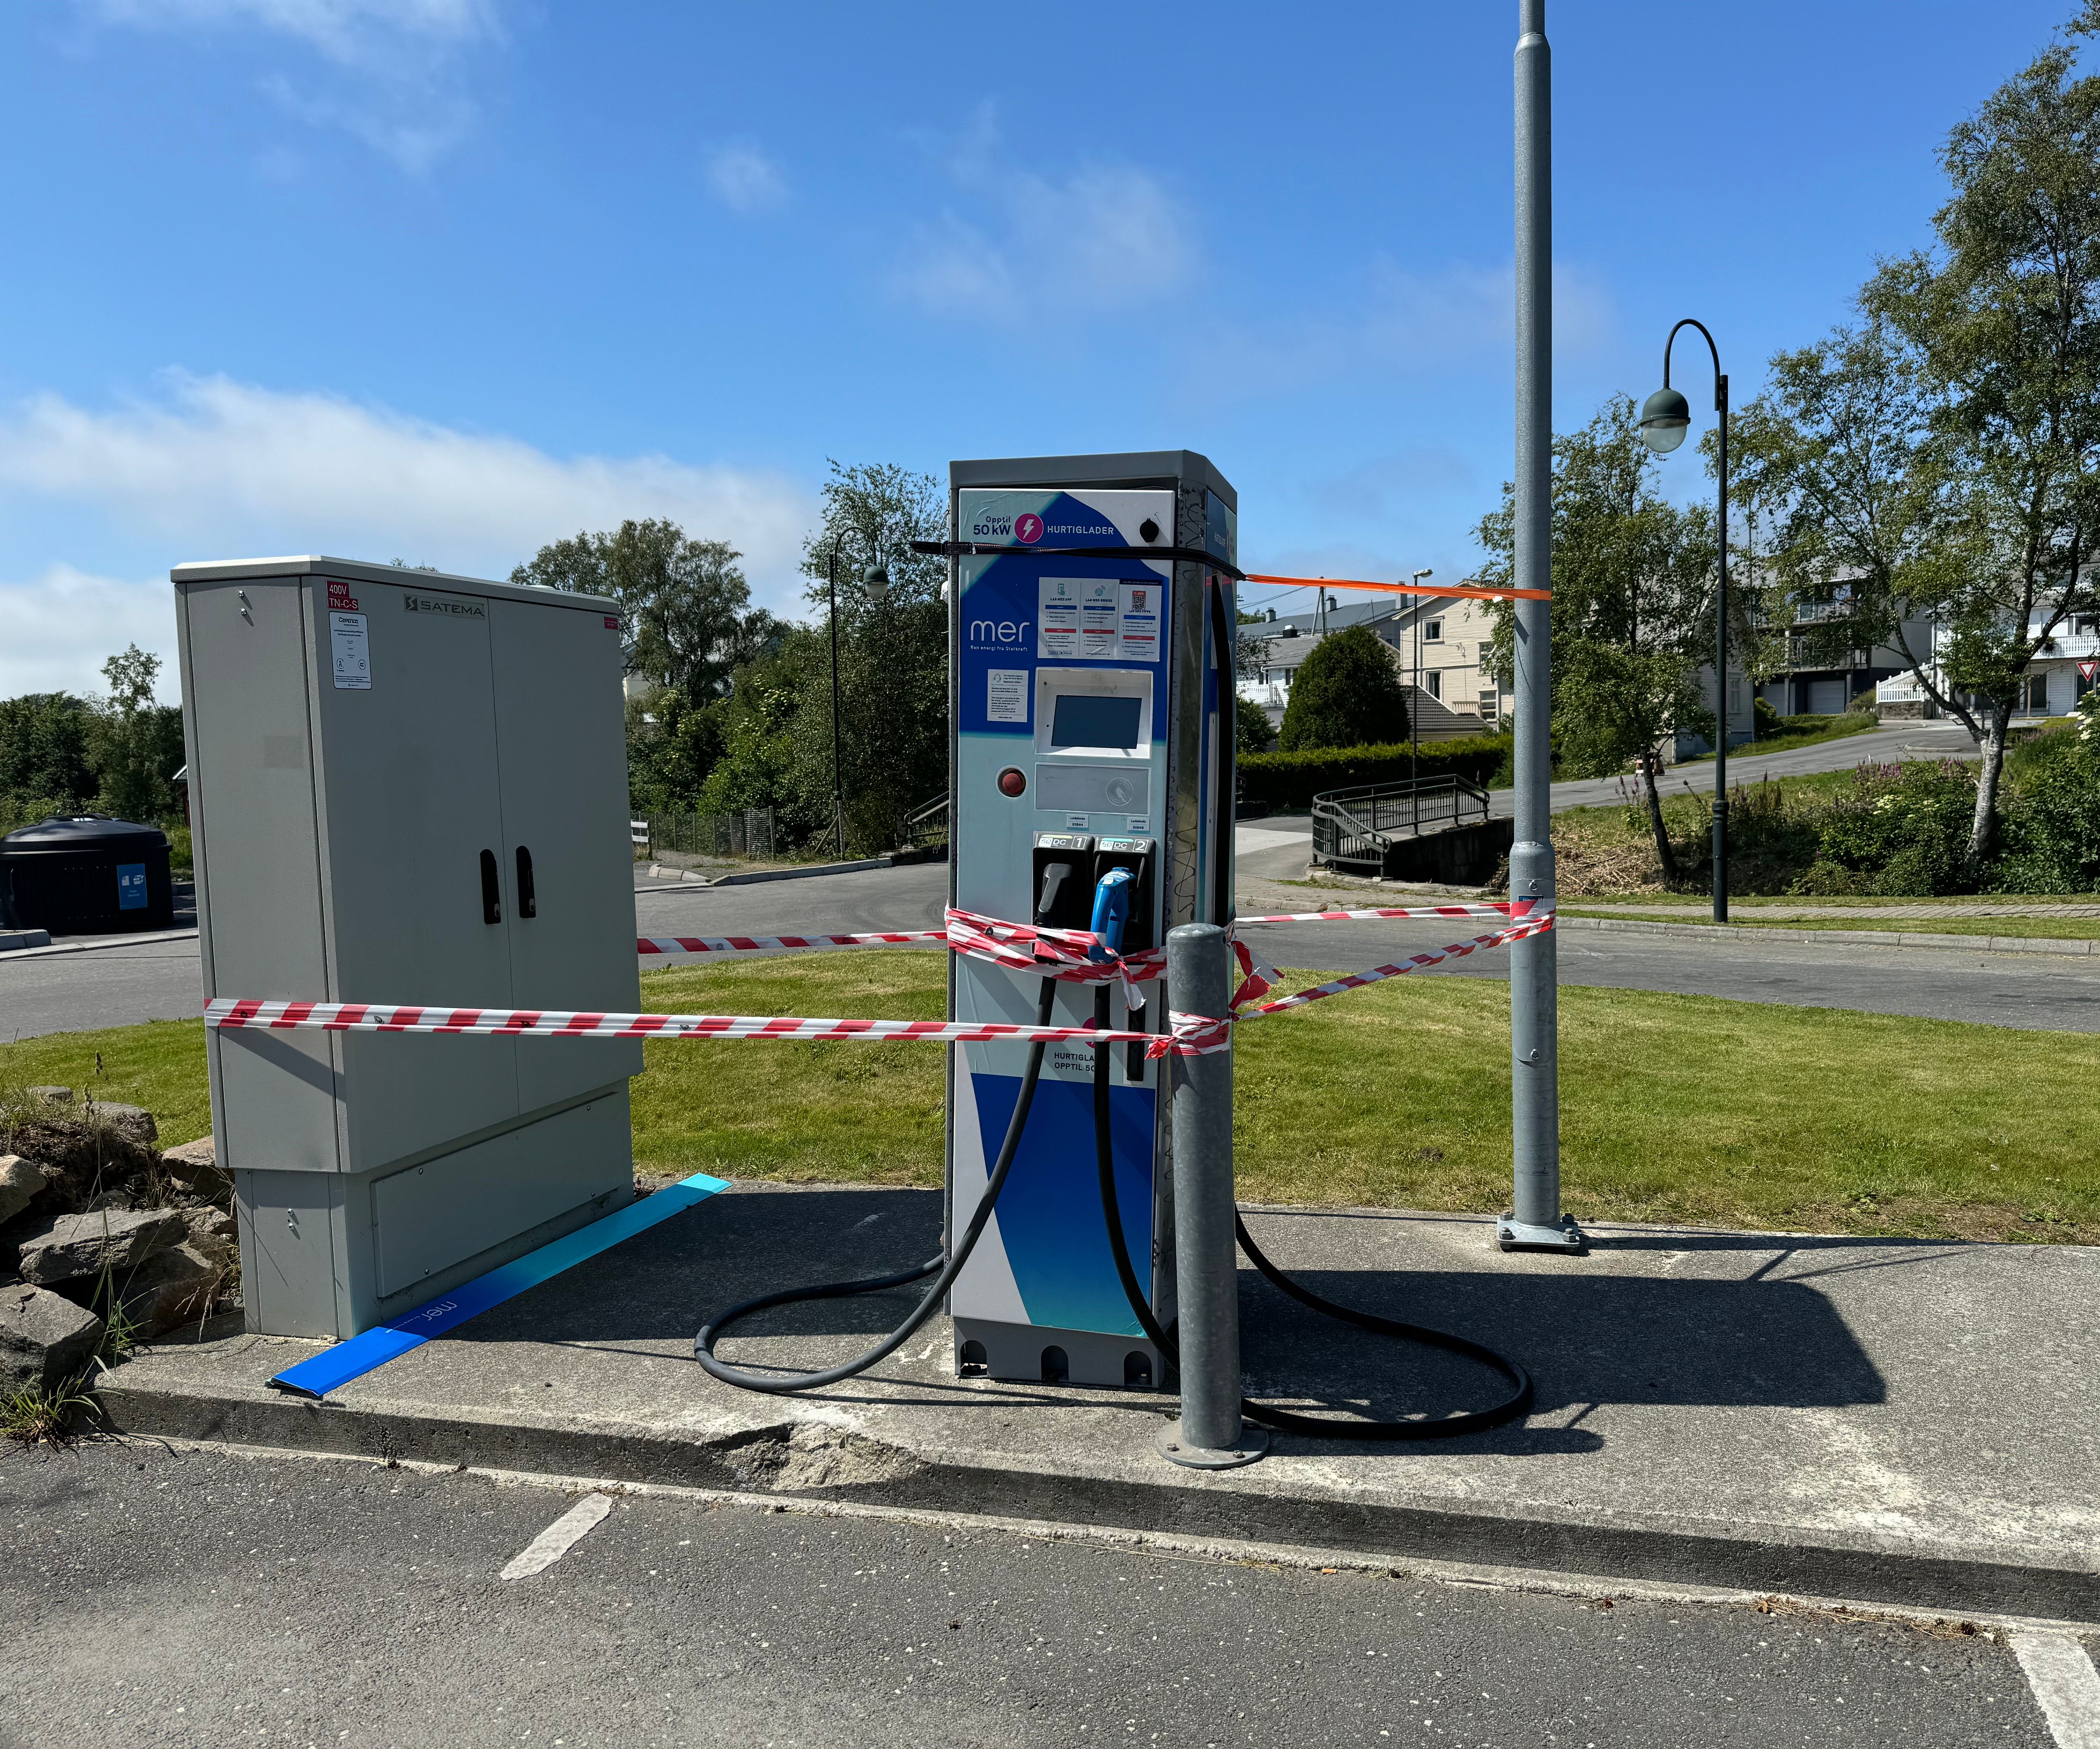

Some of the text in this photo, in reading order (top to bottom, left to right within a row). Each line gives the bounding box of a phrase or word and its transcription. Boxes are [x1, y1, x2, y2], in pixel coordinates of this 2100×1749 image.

[986, 516, 1010, 524] Opptil
[973, 524, 1011, 535] 50 kW
[1048, 525, 1114, 535] HURTIGLADER
[329, 585, 347, 595] 400V
[329, 598, 358, 609] TN-C-S
[420, 601, 485, 616] SATEMA
[970, 620, 1030, 643] mer
[1077, 837, 1082, 848] 1
[1135, 841, 1146, 851] 2
[1054, 1052, 1094, 1061] HURTIGLA
[1054, 1062, 1083, 1071] OPPTIL
[421, 1301, 457, 1321] mer
